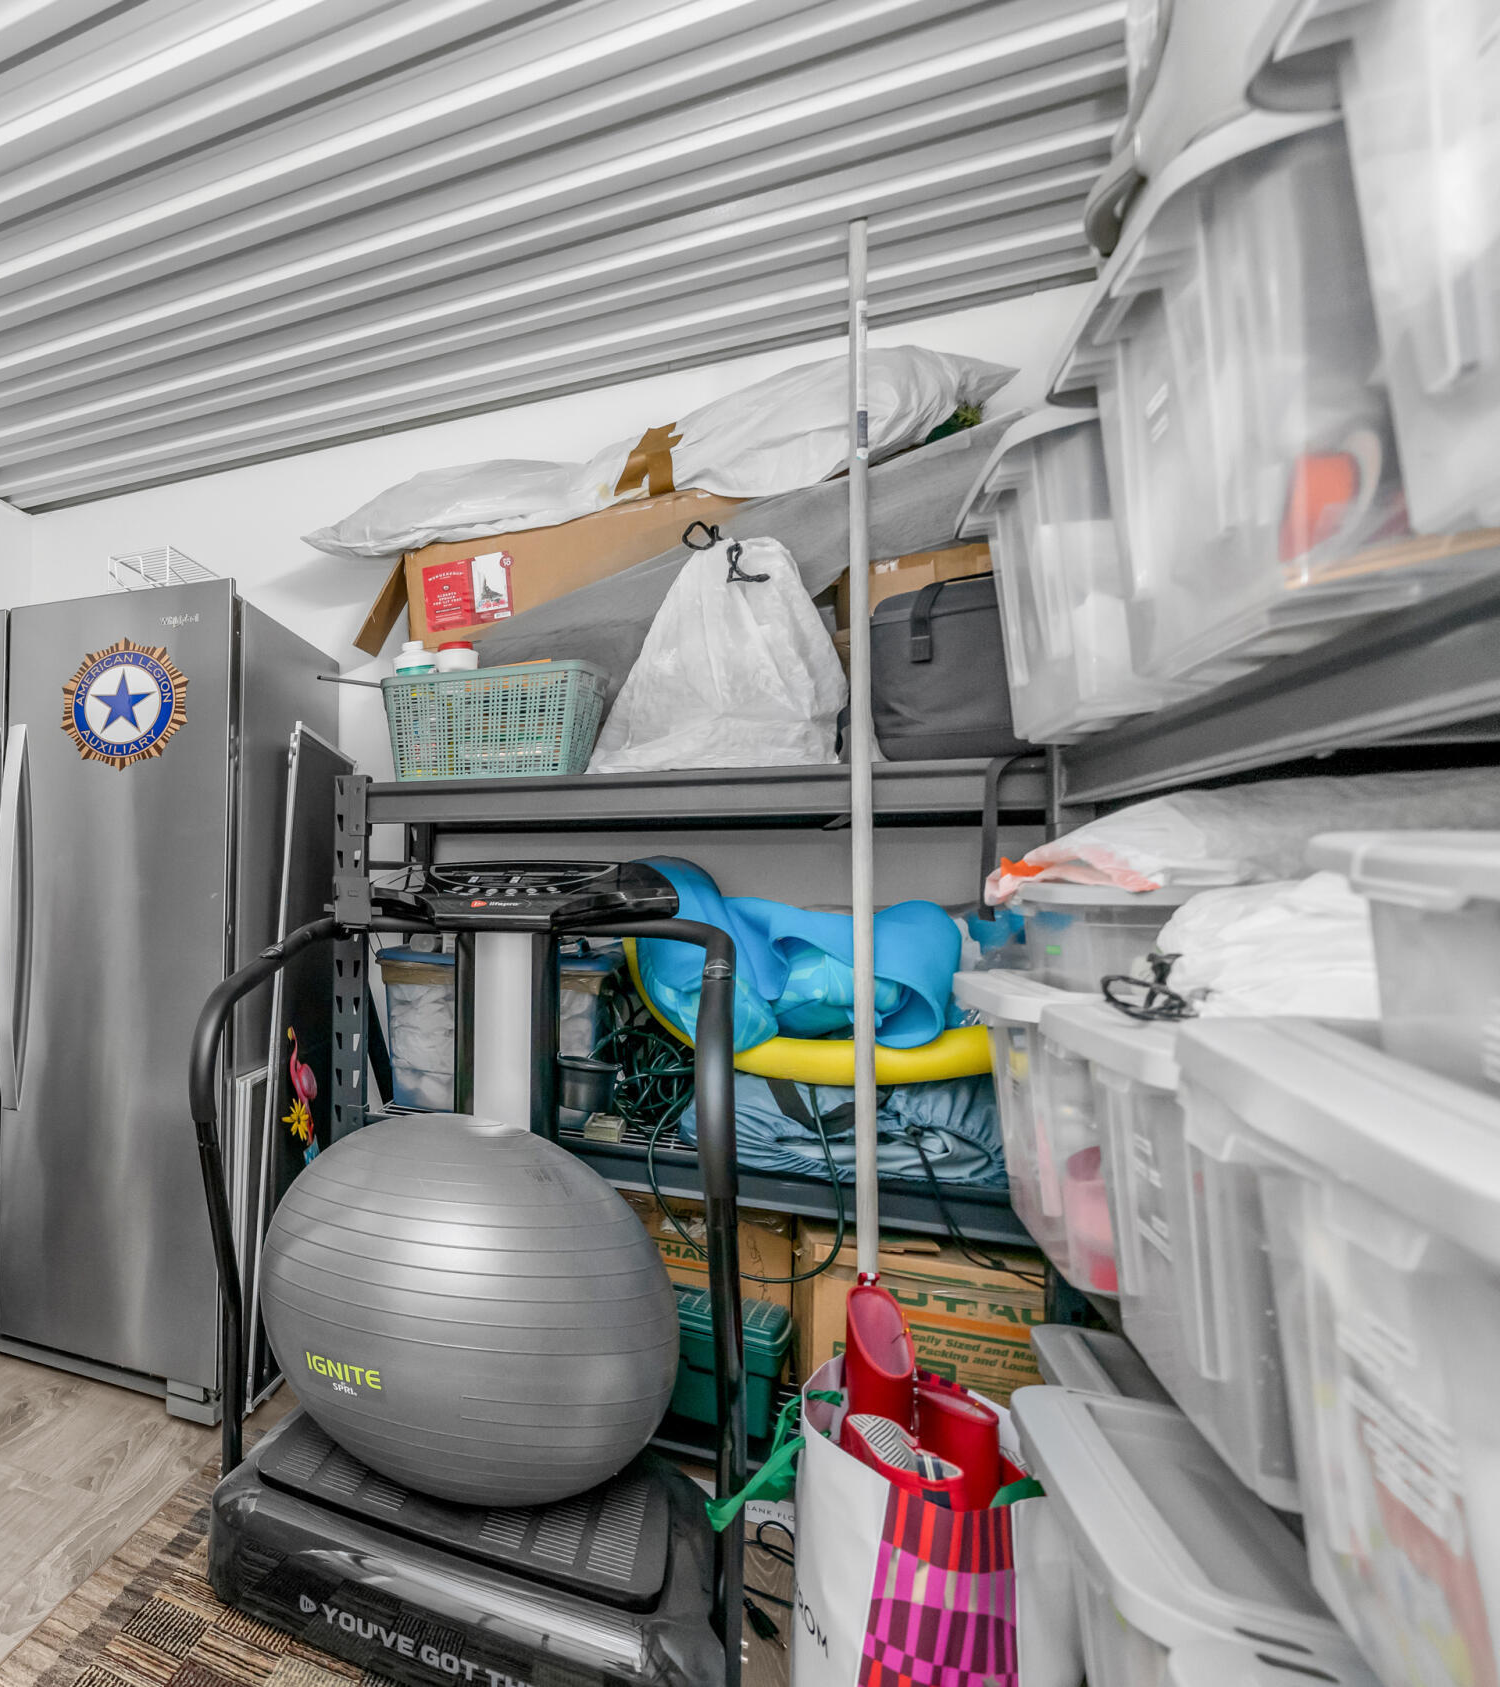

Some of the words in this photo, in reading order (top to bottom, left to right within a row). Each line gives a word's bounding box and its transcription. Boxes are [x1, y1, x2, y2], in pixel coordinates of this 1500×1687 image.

[75, 653, 134, 706] AMERICAN
[138, 655, 172, 703] LEGION
[81, 729, 156, 755] AUXILIARY
[918, 1345, 969, 1364] Packing
[973, 1355, 998, 1367] and
[946, 1339, 981, 1352] Sized
[983, 1345, 1009, 1359] and
[306, 1352, 382, 1390] IGNITE
[321, 1603, 414, 1657] YOU'VE
[420, 1644, 479, 1681] GOT
